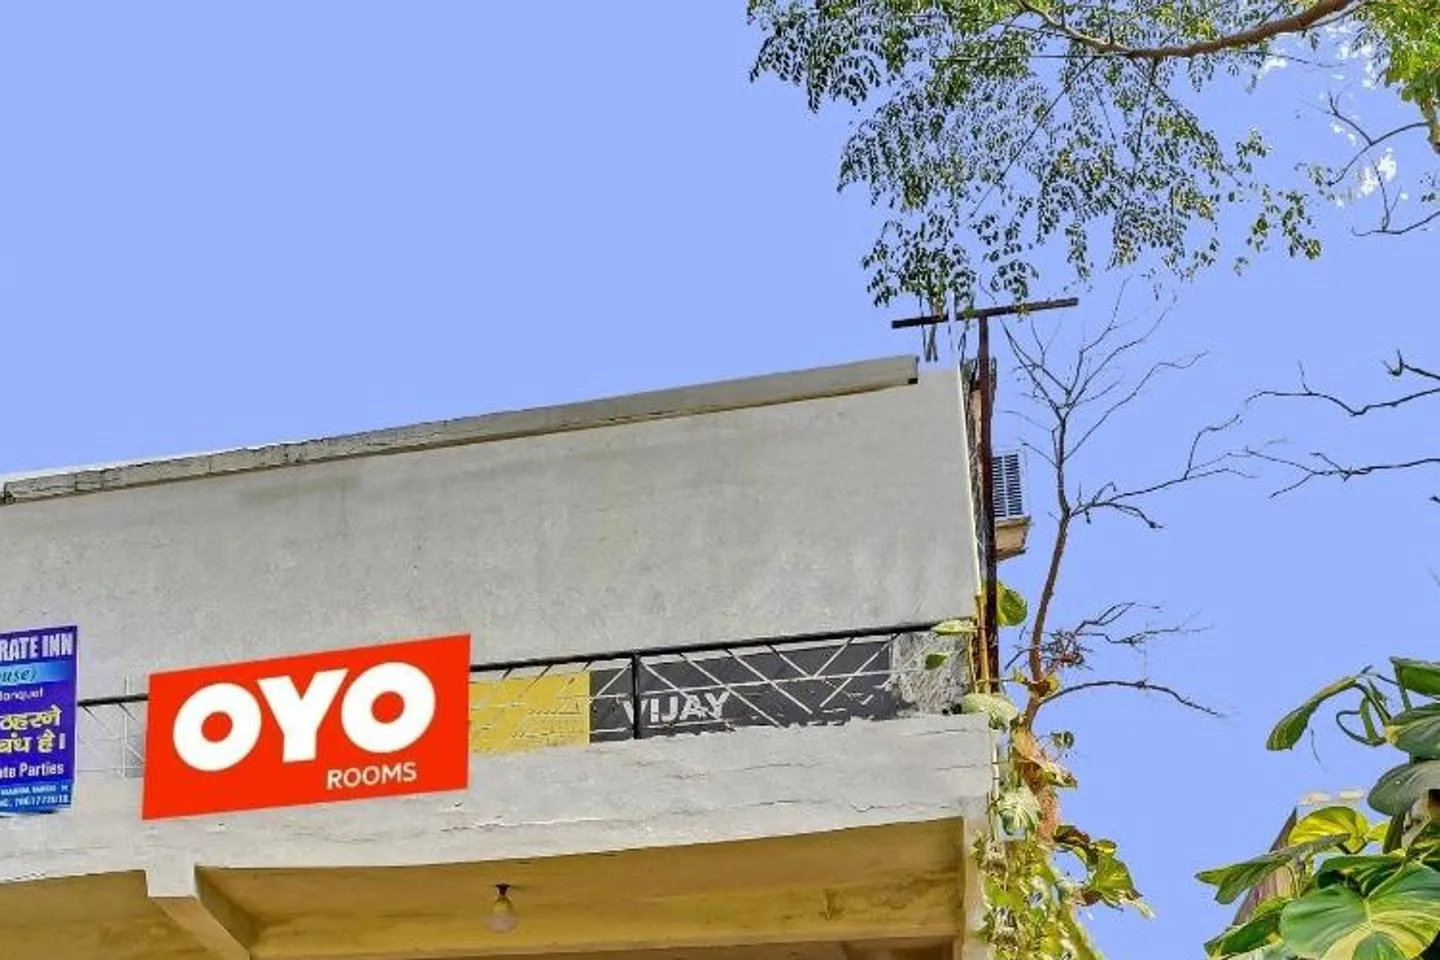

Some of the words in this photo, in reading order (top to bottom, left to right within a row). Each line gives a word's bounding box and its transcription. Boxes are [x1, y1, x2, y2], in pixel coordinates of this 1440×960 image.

[42, 633, 73, 658] INN
[172, 661, 436, 772] OYO
[19, 762, 64, 778] Parties
[326, 762, 417, 790] ROOMS
